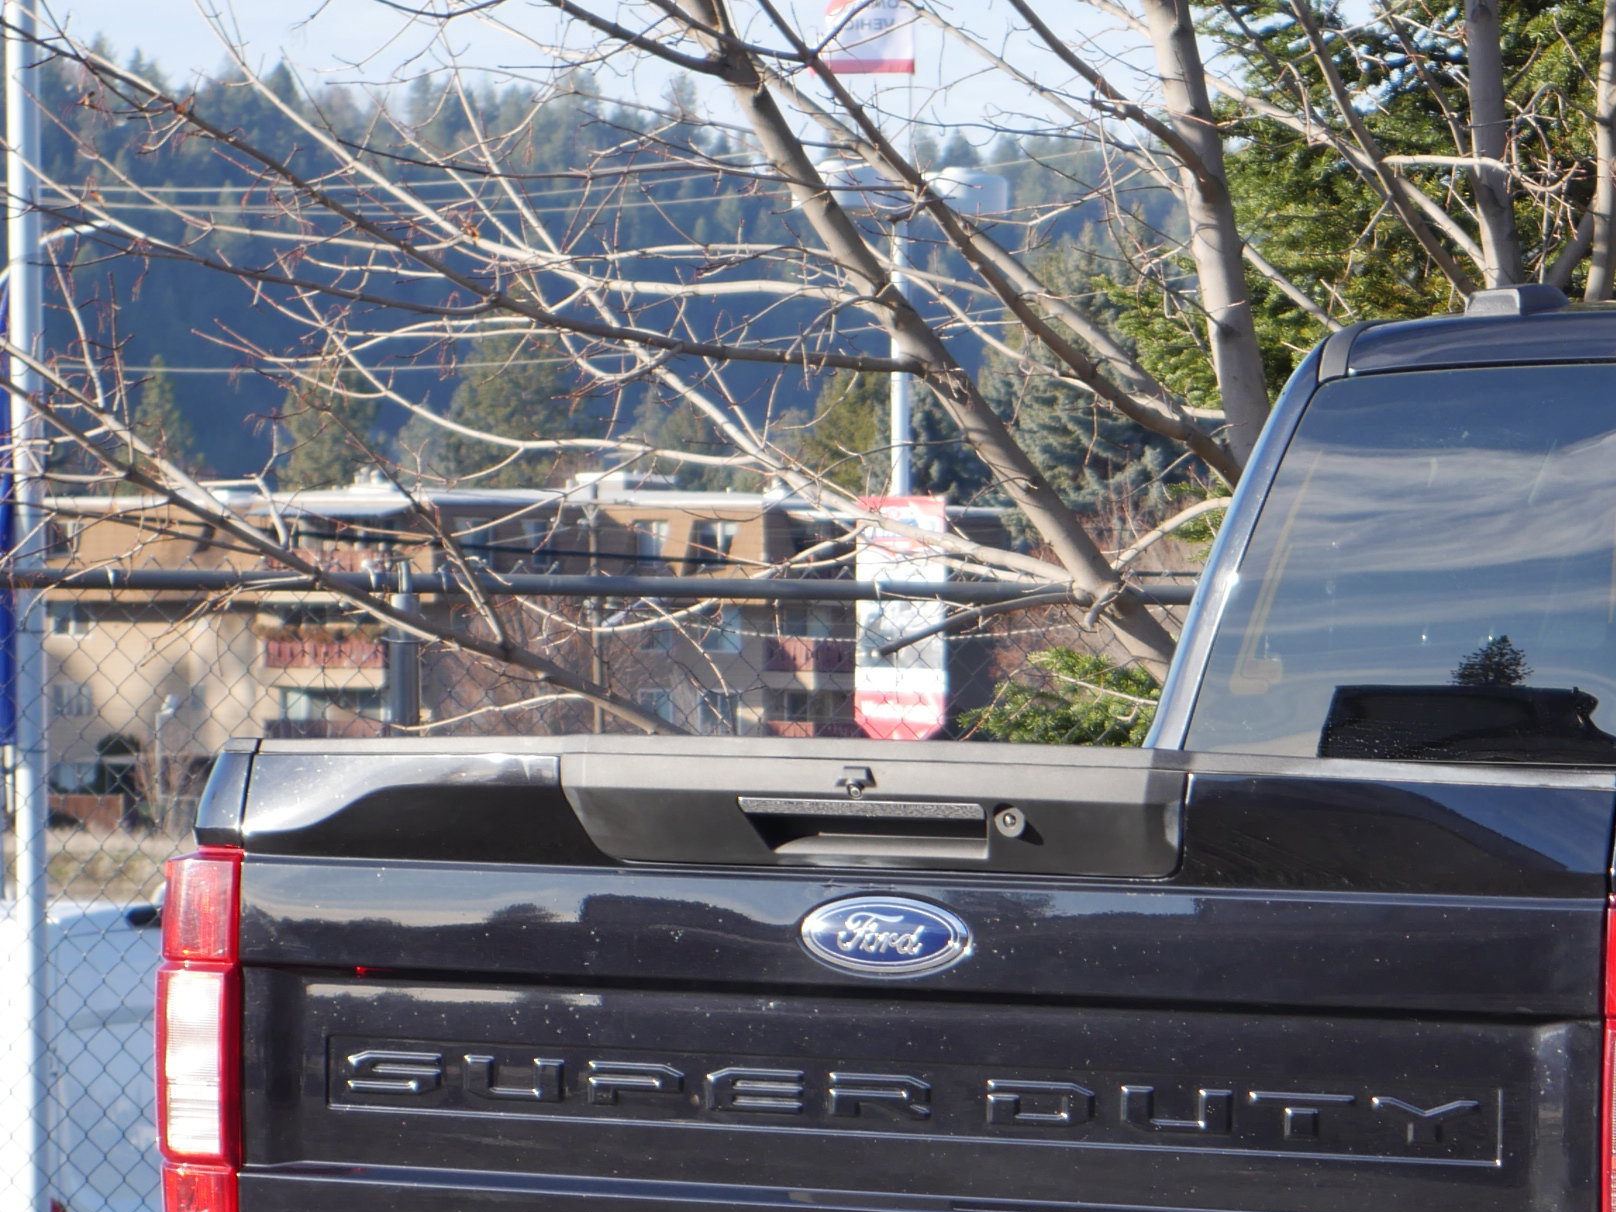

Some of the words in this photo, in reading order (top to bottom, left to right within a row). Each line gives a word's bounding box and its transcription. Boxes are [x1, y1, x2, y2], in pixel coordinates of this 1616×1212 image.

[836, 911, 925, 955] Ford
[347, 1050, 932, 1121] SUPER
[985, 1078, 1481, 1144] DUTY
